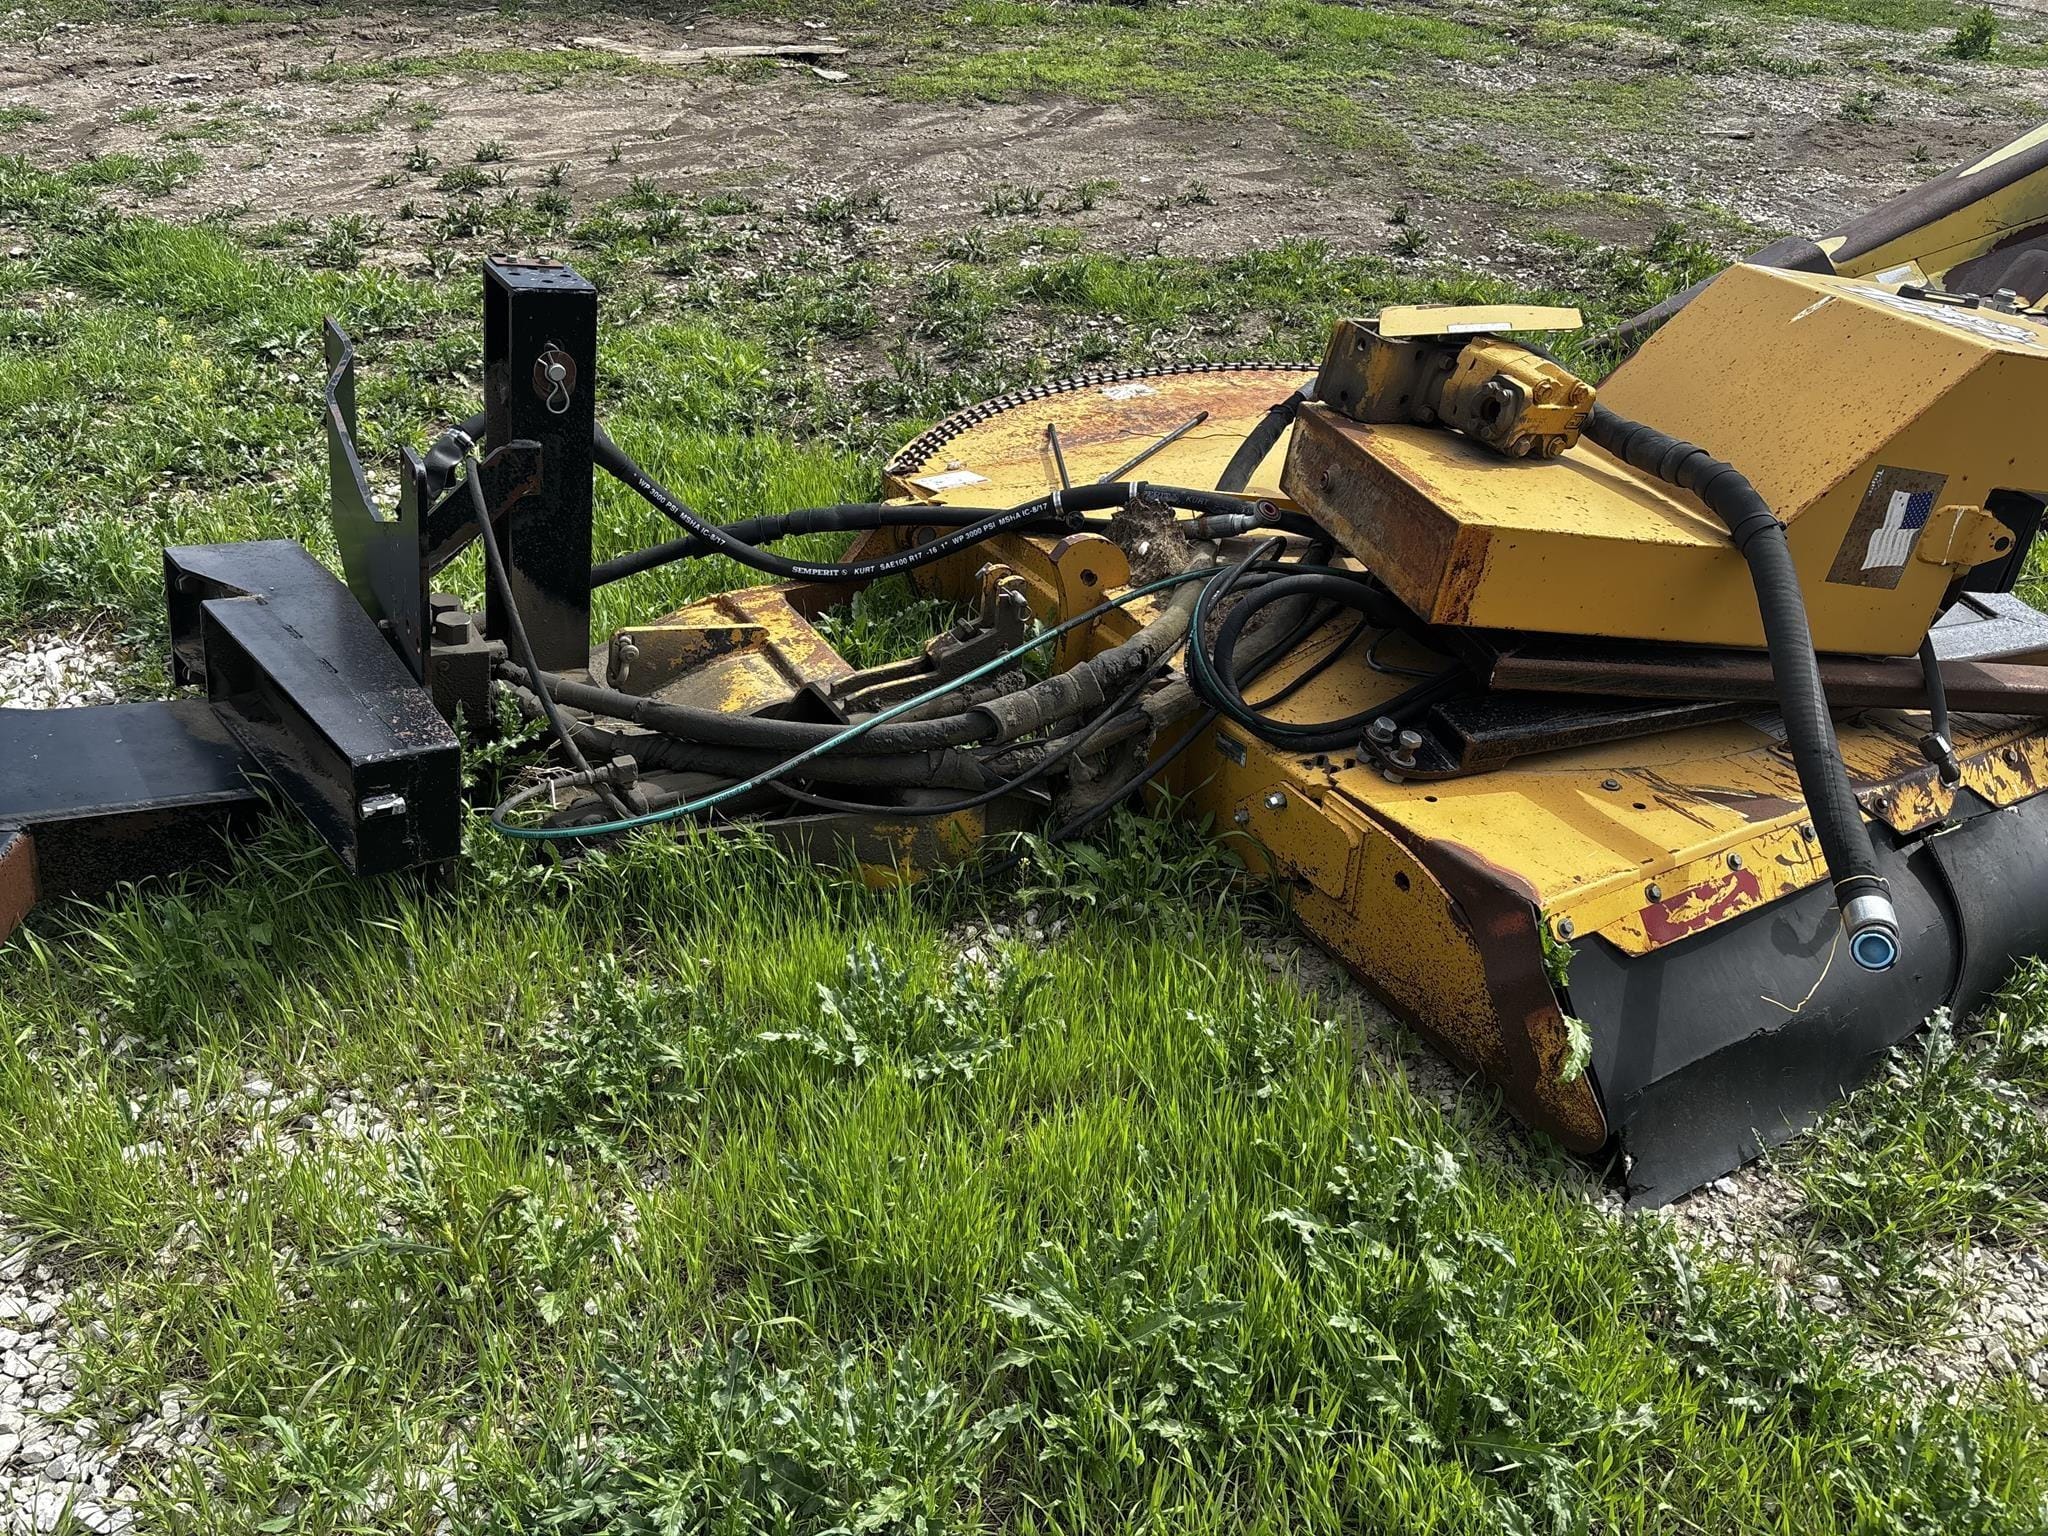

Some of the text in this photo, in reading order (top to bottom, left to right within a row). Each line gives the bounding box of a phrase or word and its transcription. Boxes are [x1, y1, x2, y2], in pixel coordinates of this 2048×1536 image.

[638, 477, 726, 546] WP 3000 PSI MSHA IC-8/17
[791, 565, 839, 576] SEMPERIT
[853, 565, 876, 575] KURT
[879, 557, 908, 571] SAE100
[908, 551, 923, 563] R17
[925, 546, 938, 556] -16
[951, 534, 965, 545] WP
[965, 526, 983, 540] 3000
[982, 521, 996, 533] PSI
[998, 511, 1021, 526] MSHA
[1021, 502, 1048, 517] IC-8/17
